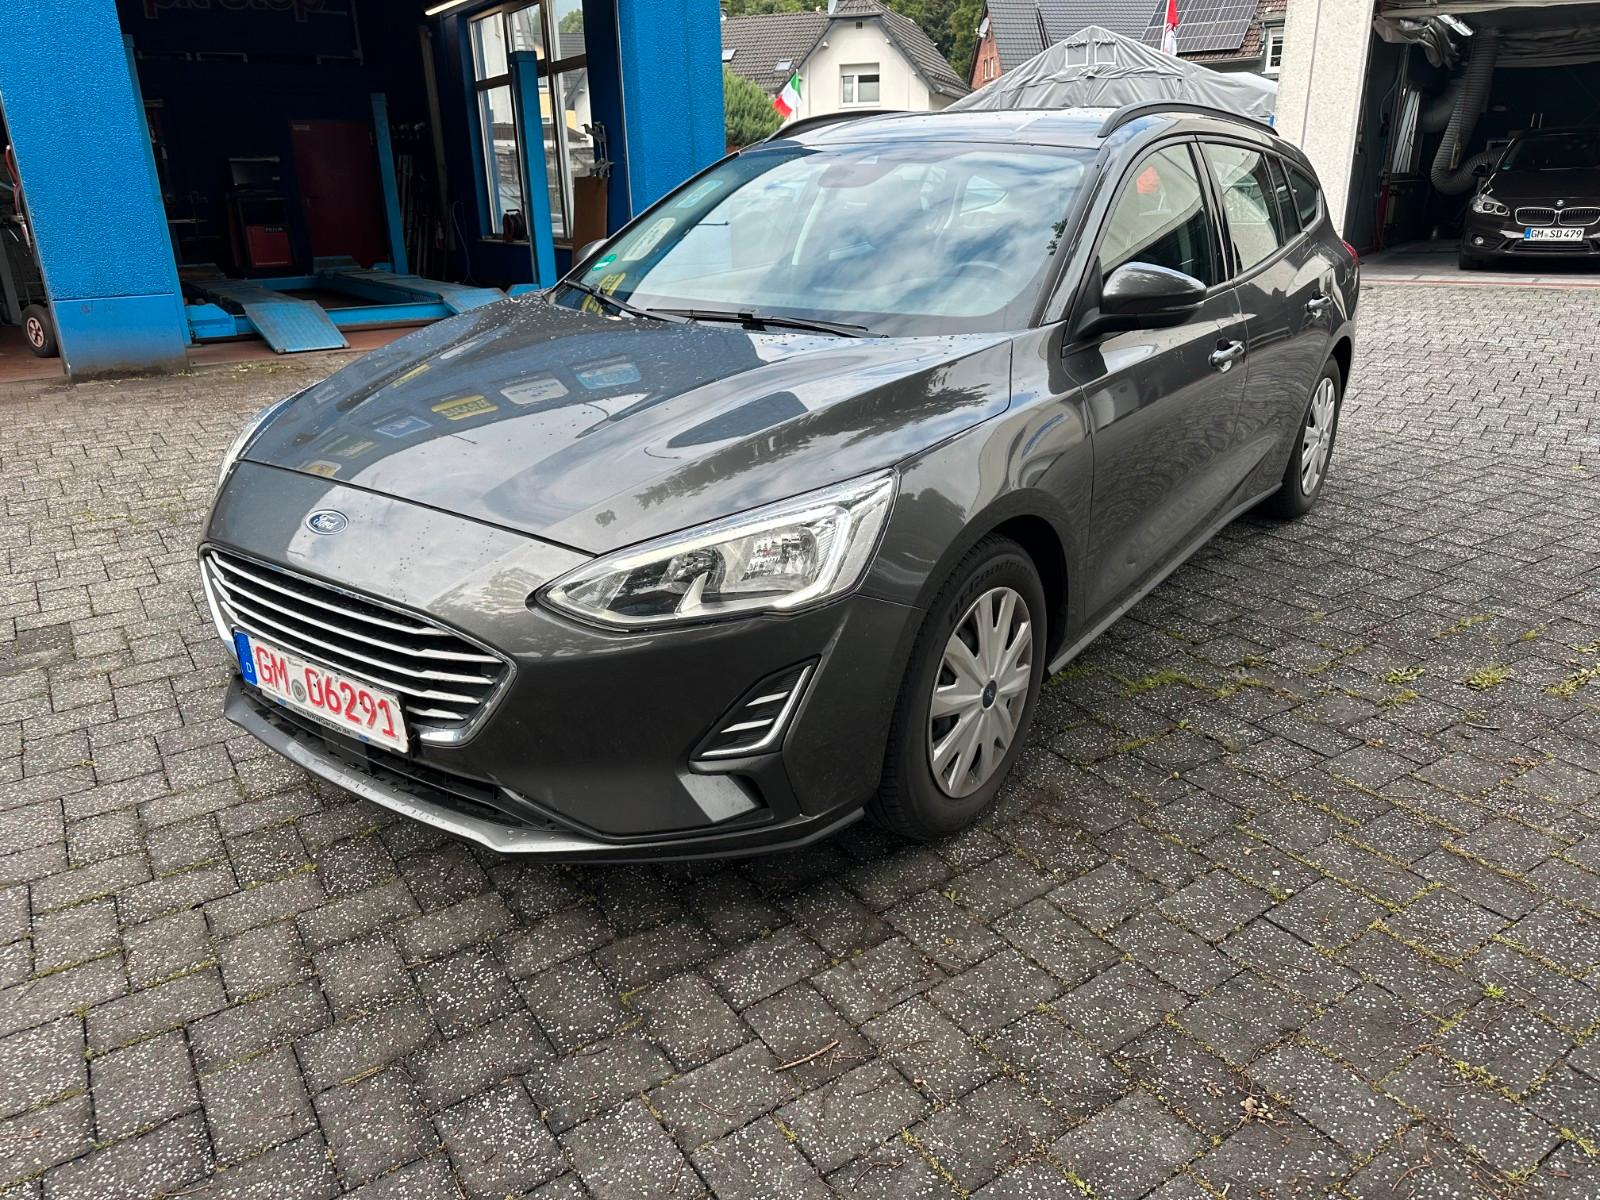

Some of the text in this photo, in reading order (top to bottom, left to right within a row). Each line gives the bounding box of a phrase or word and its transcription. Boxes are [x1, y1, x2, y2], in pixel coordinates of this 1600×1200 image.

[1531, 229, 1544, 238] GM
[1549, 229, 1563, 238] SD
[1564, 229, 1583, 238] 479
[255, 646, 397, 738] GM 06291
